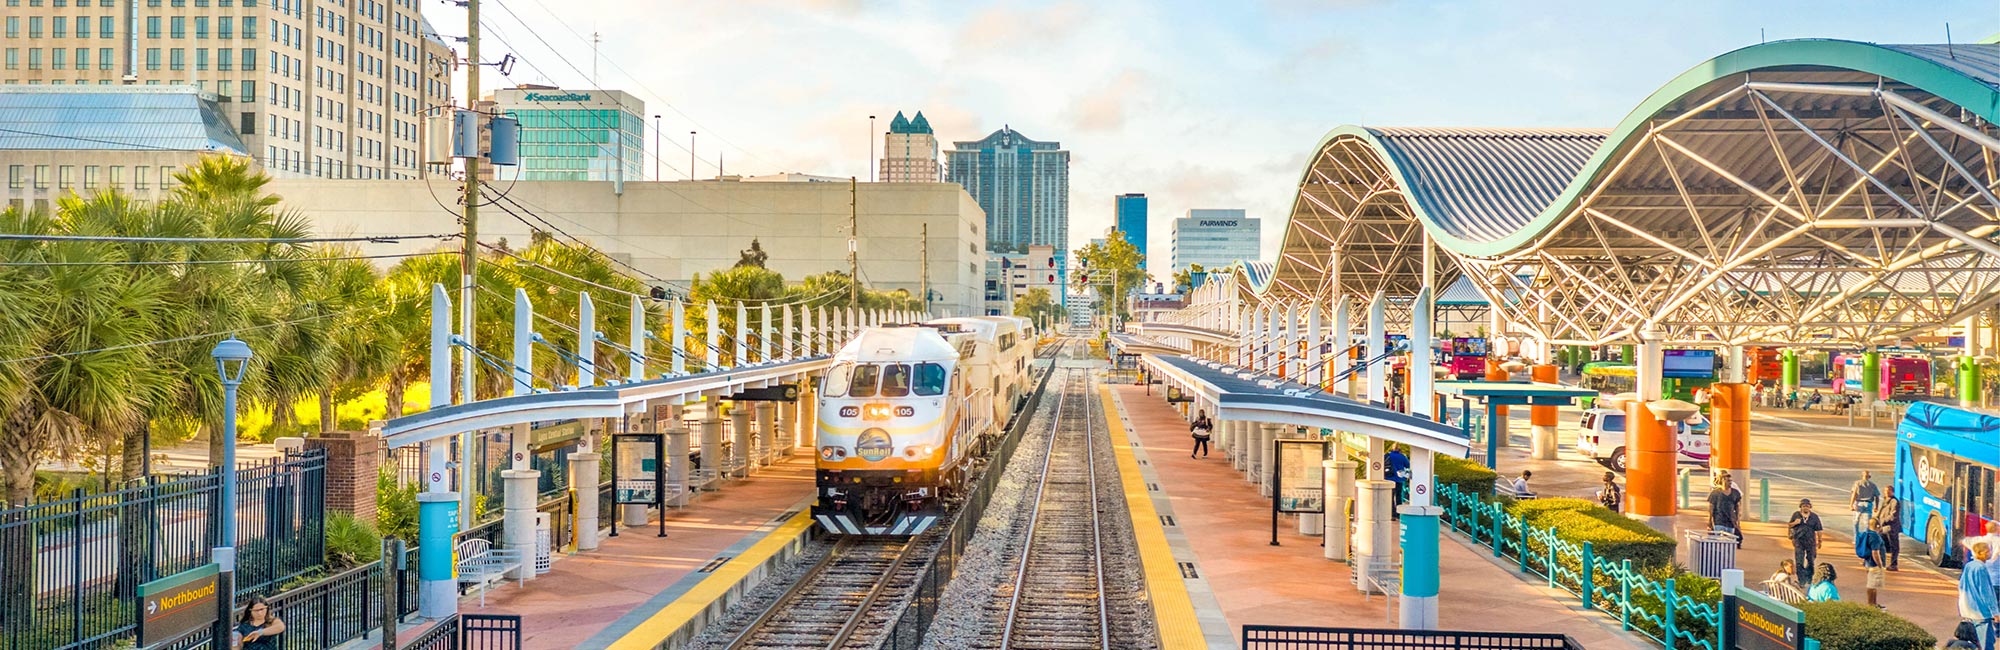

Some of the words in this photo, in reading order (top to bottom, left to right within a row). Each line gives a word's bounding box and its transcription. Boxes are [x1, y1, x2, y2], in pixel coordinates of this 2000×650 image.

[841, 408, 858, 416] 105
[895, 407, 912, 416] 105
[857, 447, 891, 457] SunRail
[1929, 466, 1945, 485] LYNX
[160, 581, 215, 611] Northbound
[1739, 605, 1784, 638] Southbound
